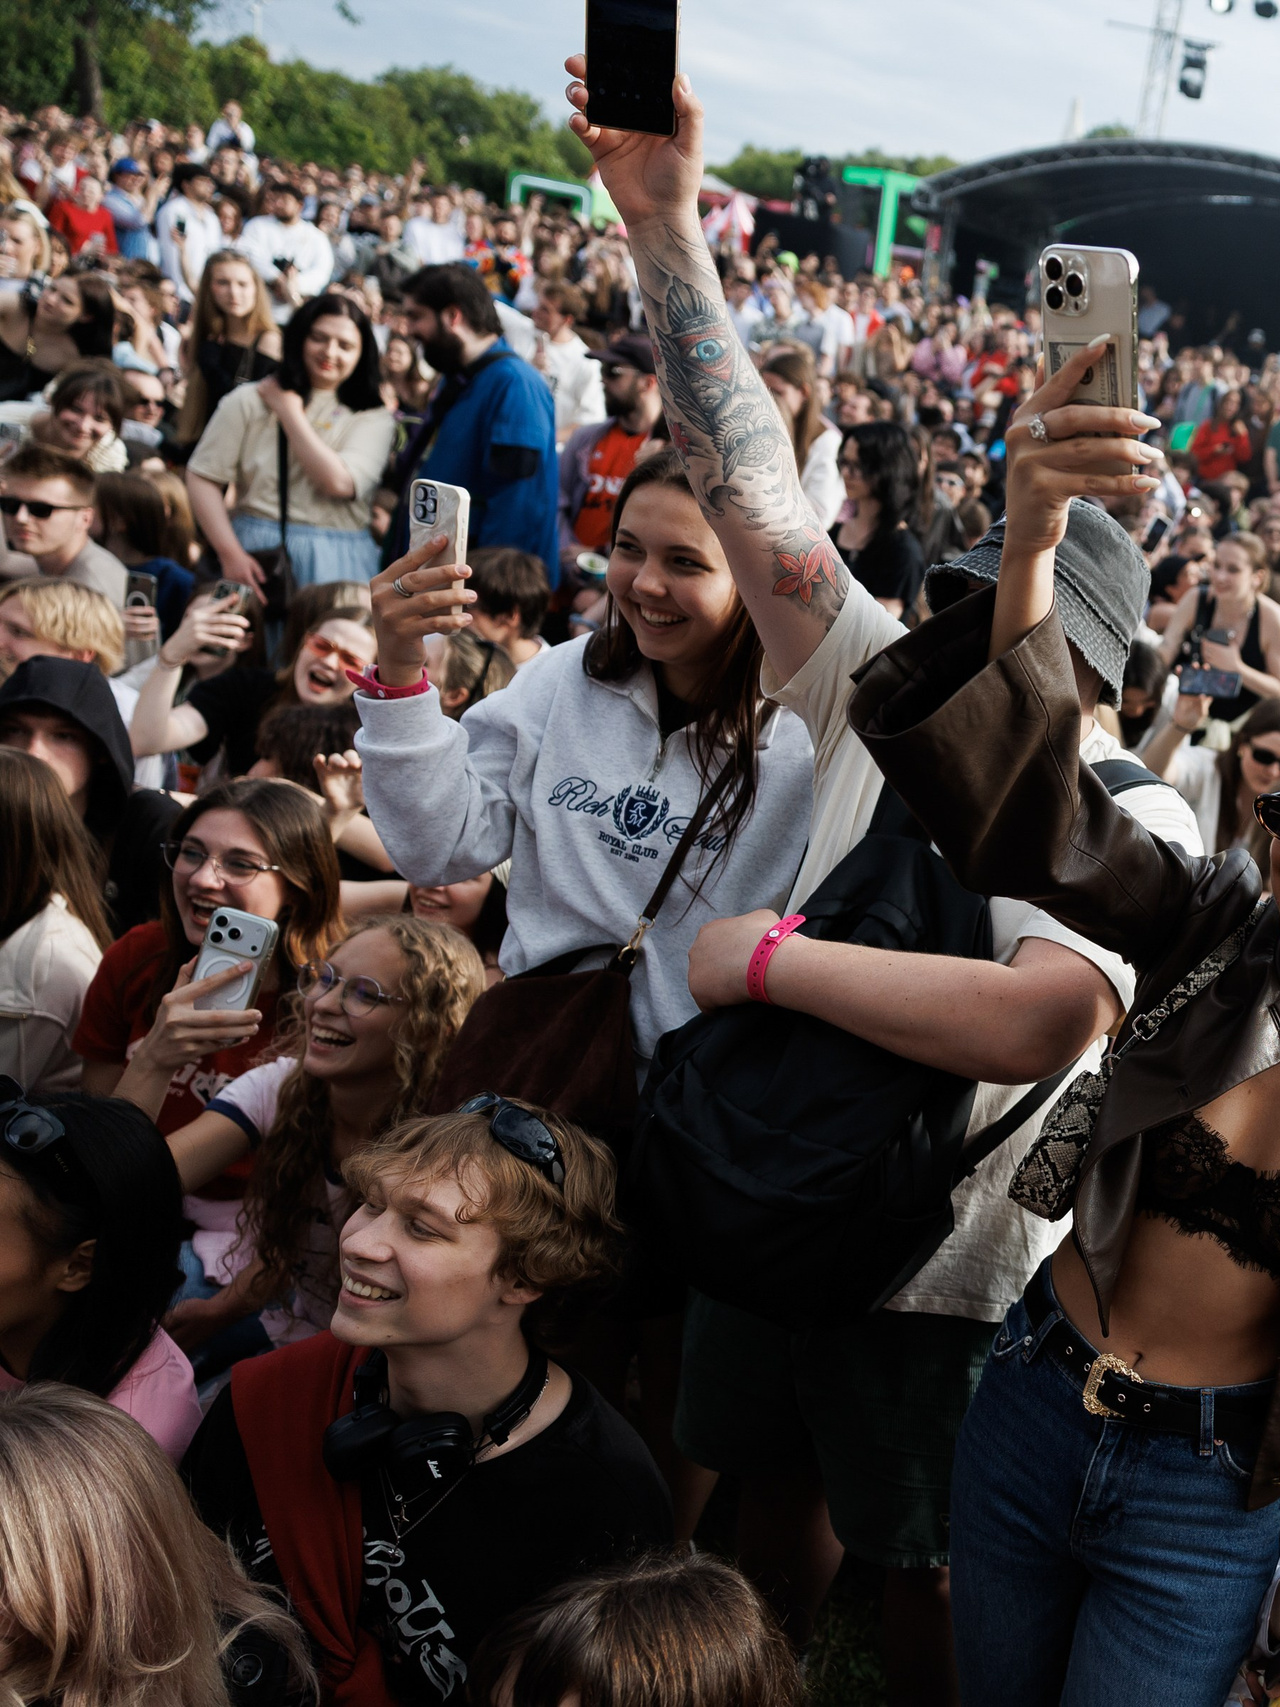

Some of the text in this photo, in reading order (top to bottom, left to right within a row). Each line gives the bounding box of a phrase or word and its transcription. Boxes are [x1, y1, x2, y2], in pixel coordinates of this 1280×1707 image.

[548, 776, 615, 818] Rich
[598, 830, 659, 859] ROYAL CLUB
[610, 847, 623, 857] EST
